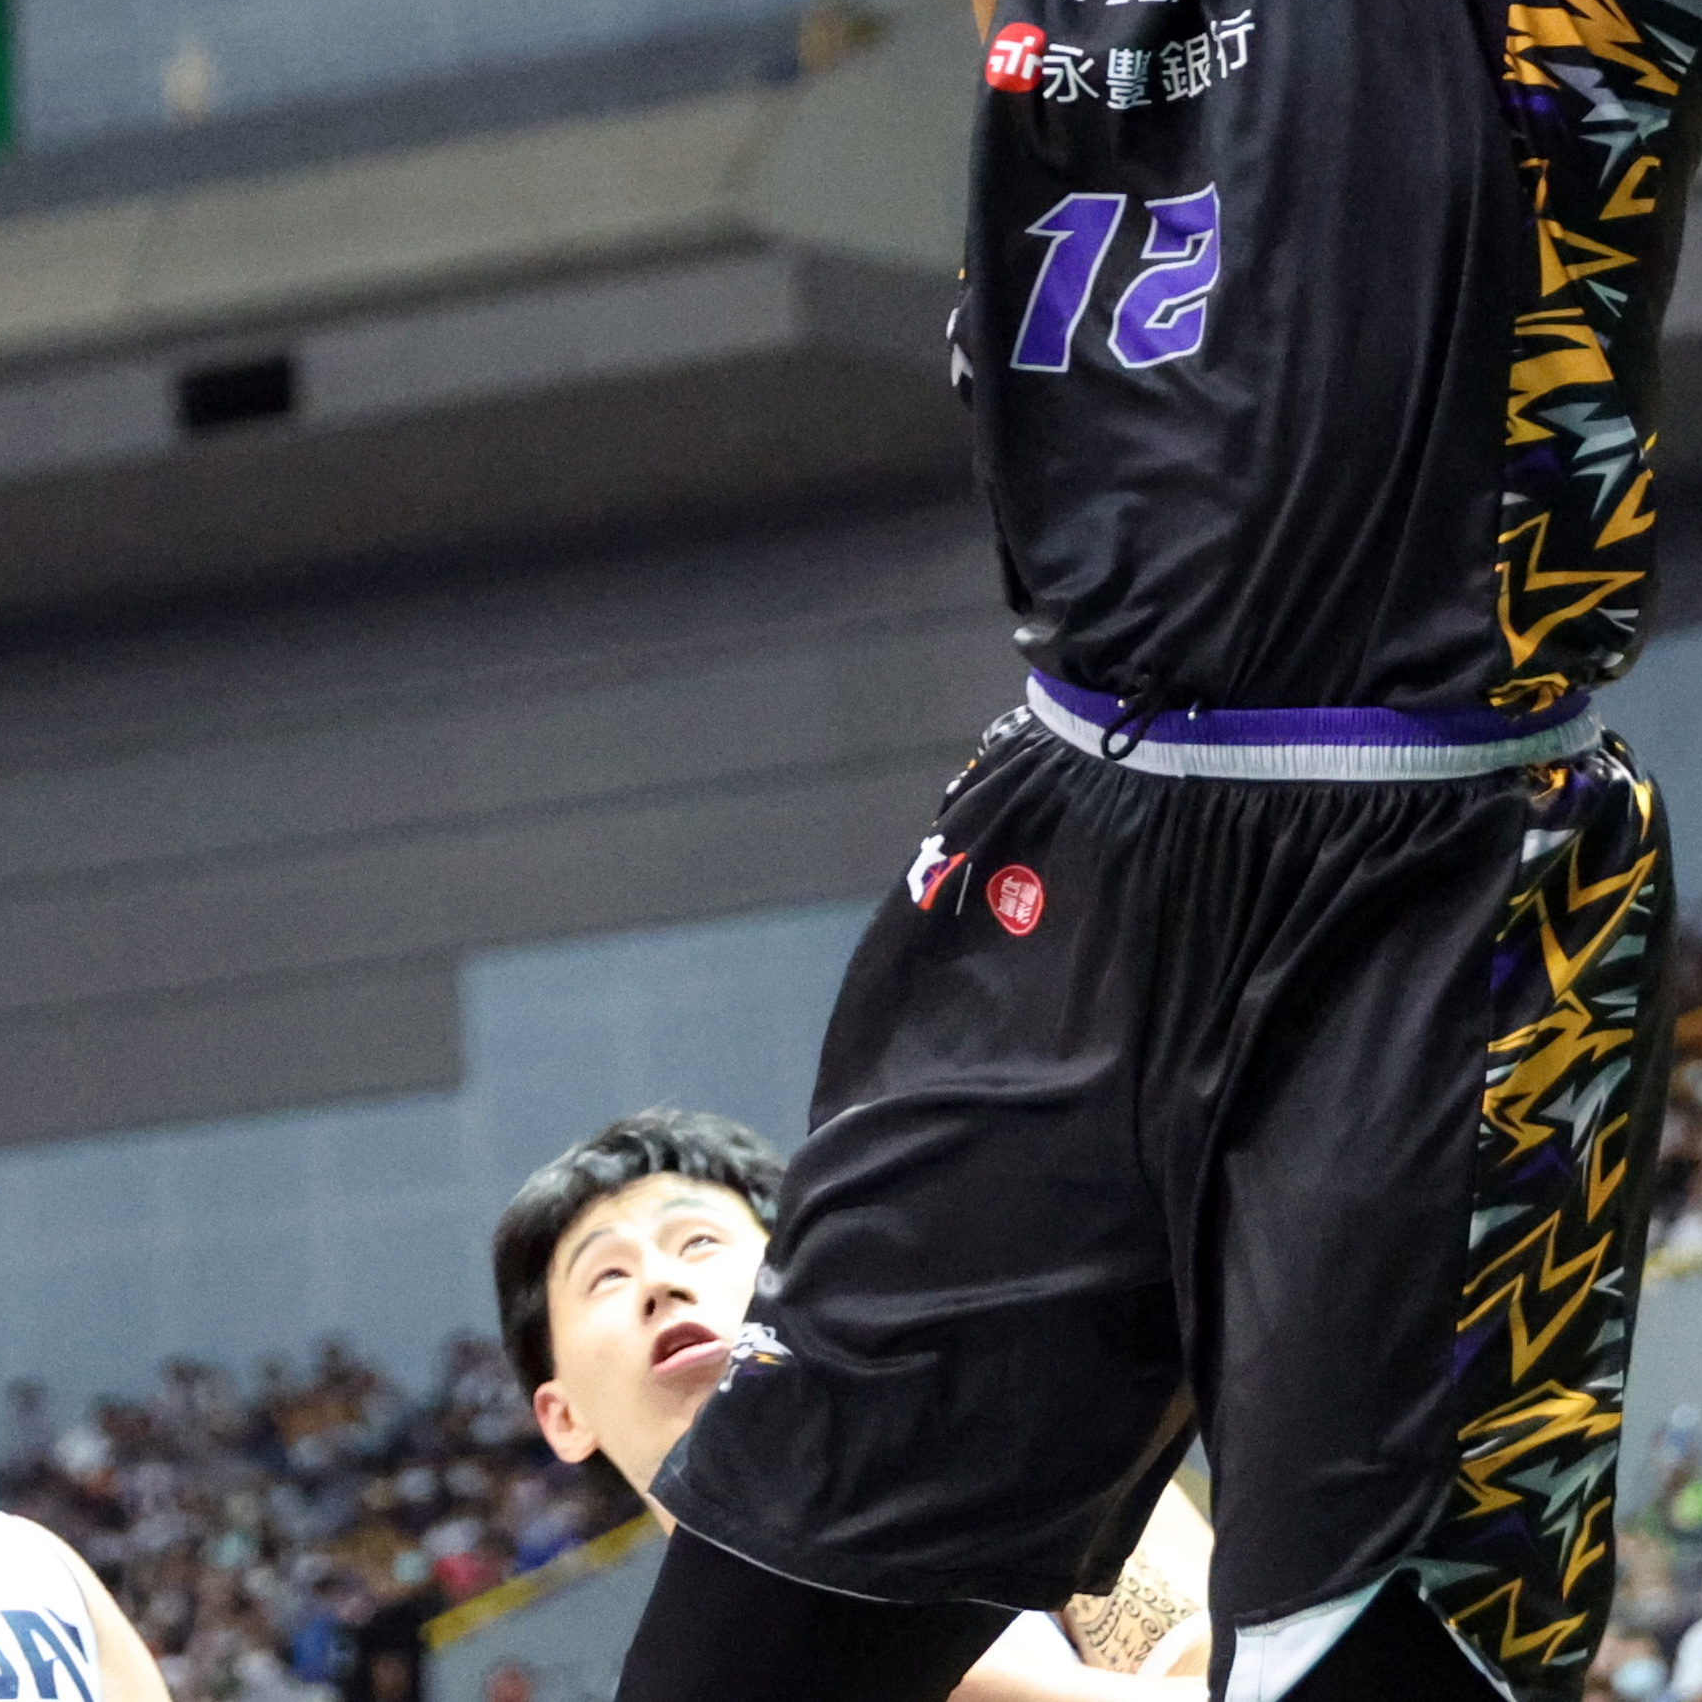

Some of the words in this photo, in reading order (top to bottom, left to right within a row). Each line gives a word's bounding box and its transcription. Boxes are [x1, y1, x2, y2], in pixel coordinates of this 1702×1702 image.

[1042, 9, 1256, 110] 永豐銀行
[1010, 181, 1221, 373] 12
